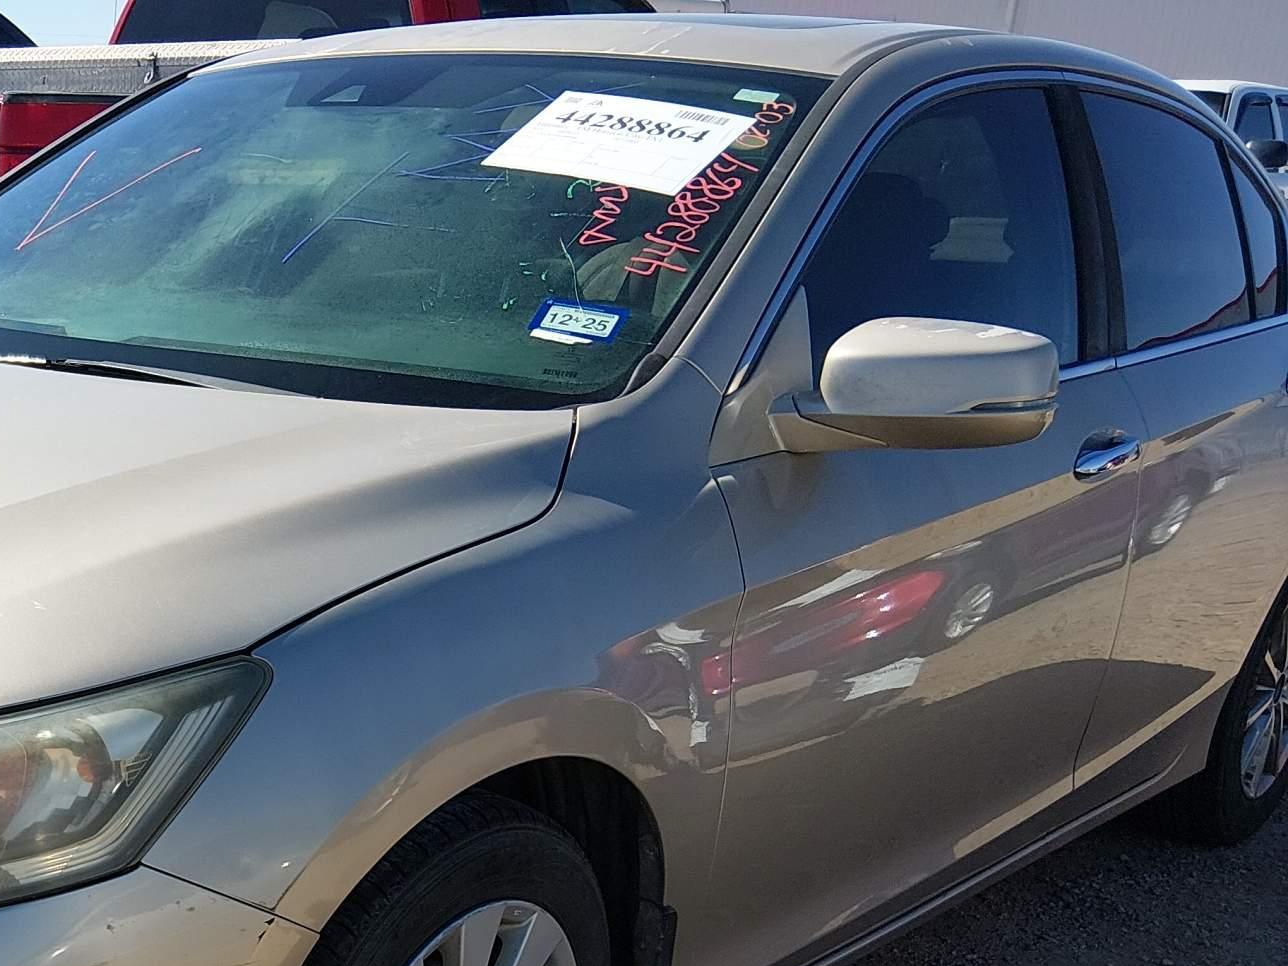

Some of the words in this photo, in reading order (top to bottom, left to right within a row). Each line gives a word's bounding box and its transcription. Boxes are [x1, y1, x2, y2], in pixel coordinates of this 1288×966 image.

[555, 110, 710, 143] 44288864
[624, 152, 760, 276] 44288864
[549, 312, 572, 326] 12
[581, 317, 610, 332] 25
